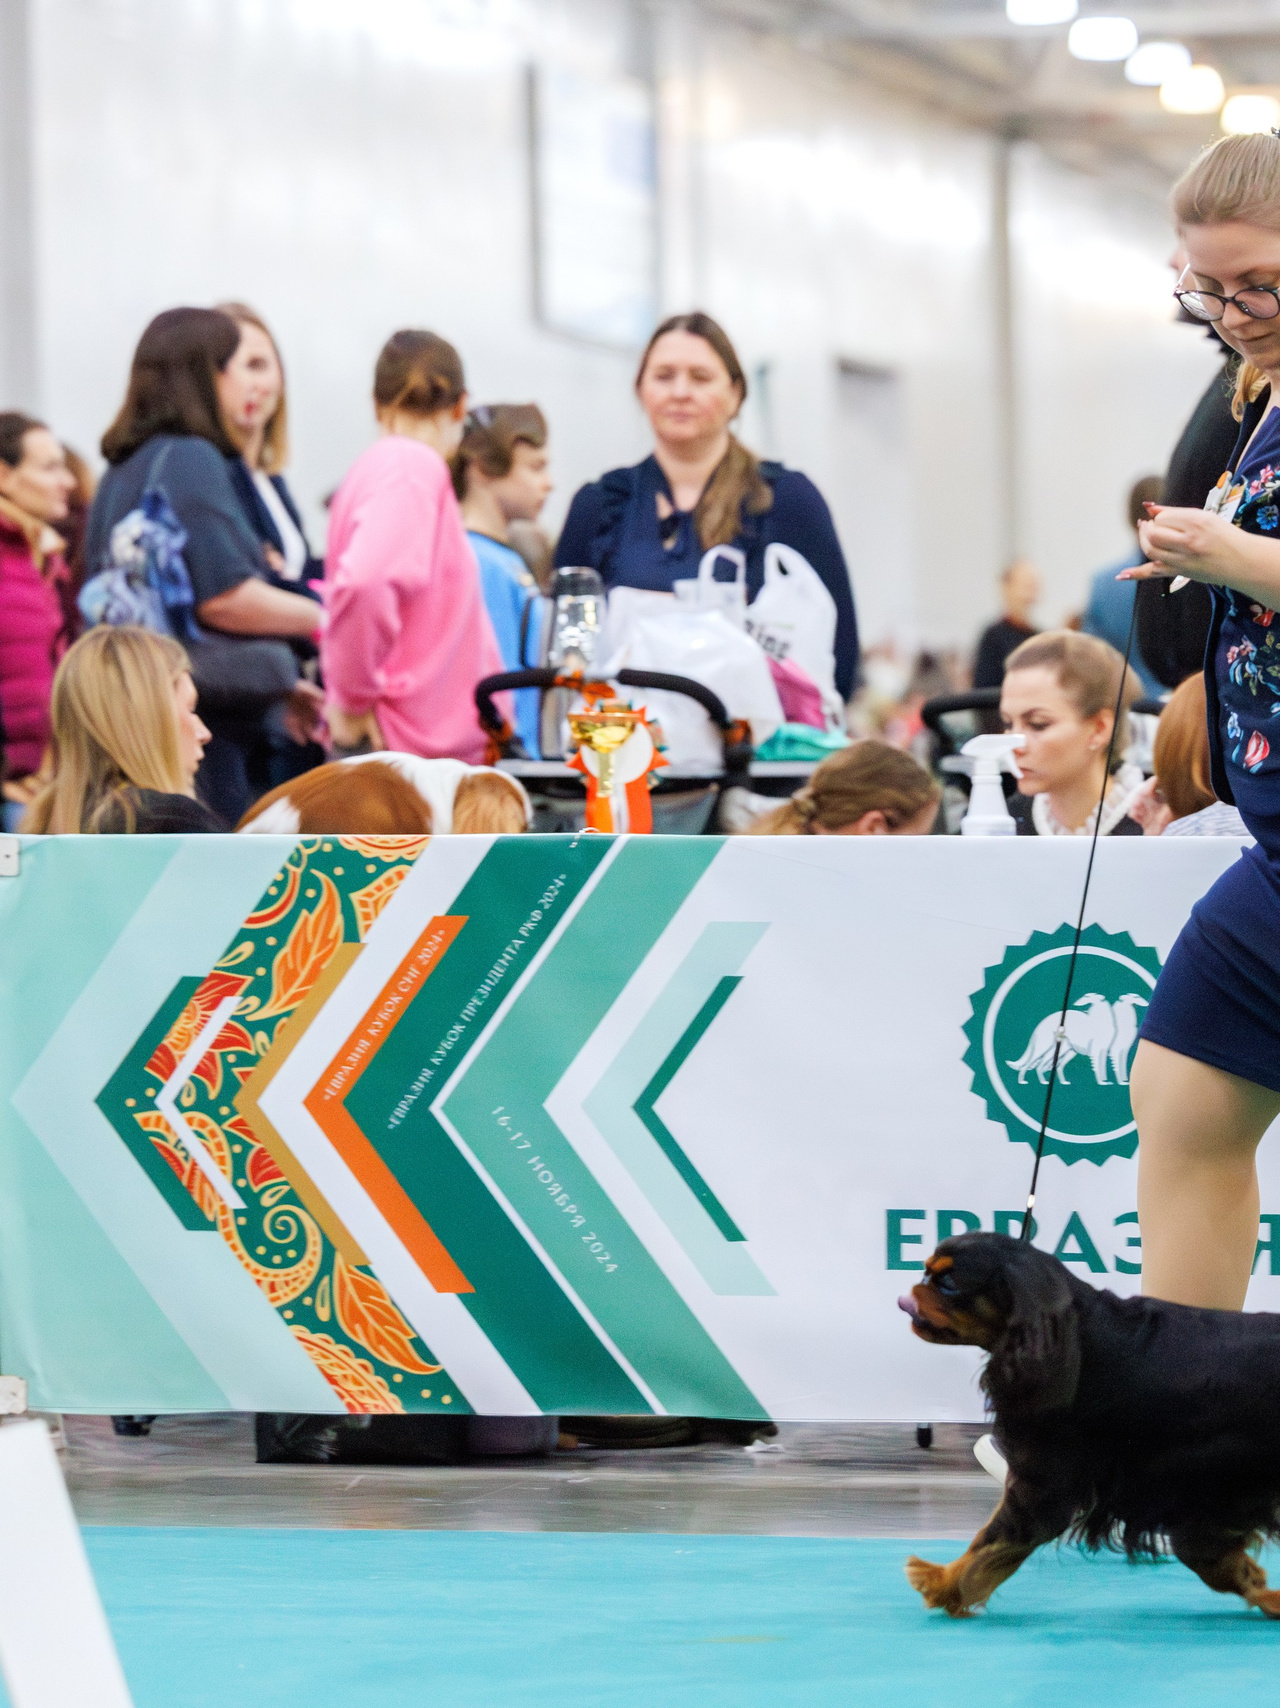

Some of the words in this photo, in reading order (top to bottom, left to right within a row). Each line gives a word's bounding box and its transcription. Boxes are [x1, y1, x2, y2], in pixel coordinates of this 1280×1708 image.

[367, 993, 403, 1036] КУБОК
[398, 965, 421, 992] СНГ
[430, 1024, 466, 1065] КУБОК
[460, 939, 525, 1022] ПРЕЗИДЕНТА
[518, 910, 543, 937] РКФ
[492, 1106, 532, 1149] 16-17
[527, 1156, 587, 1228] НОЯБРЯ
[581, 1231, 619, 1274] 2024
